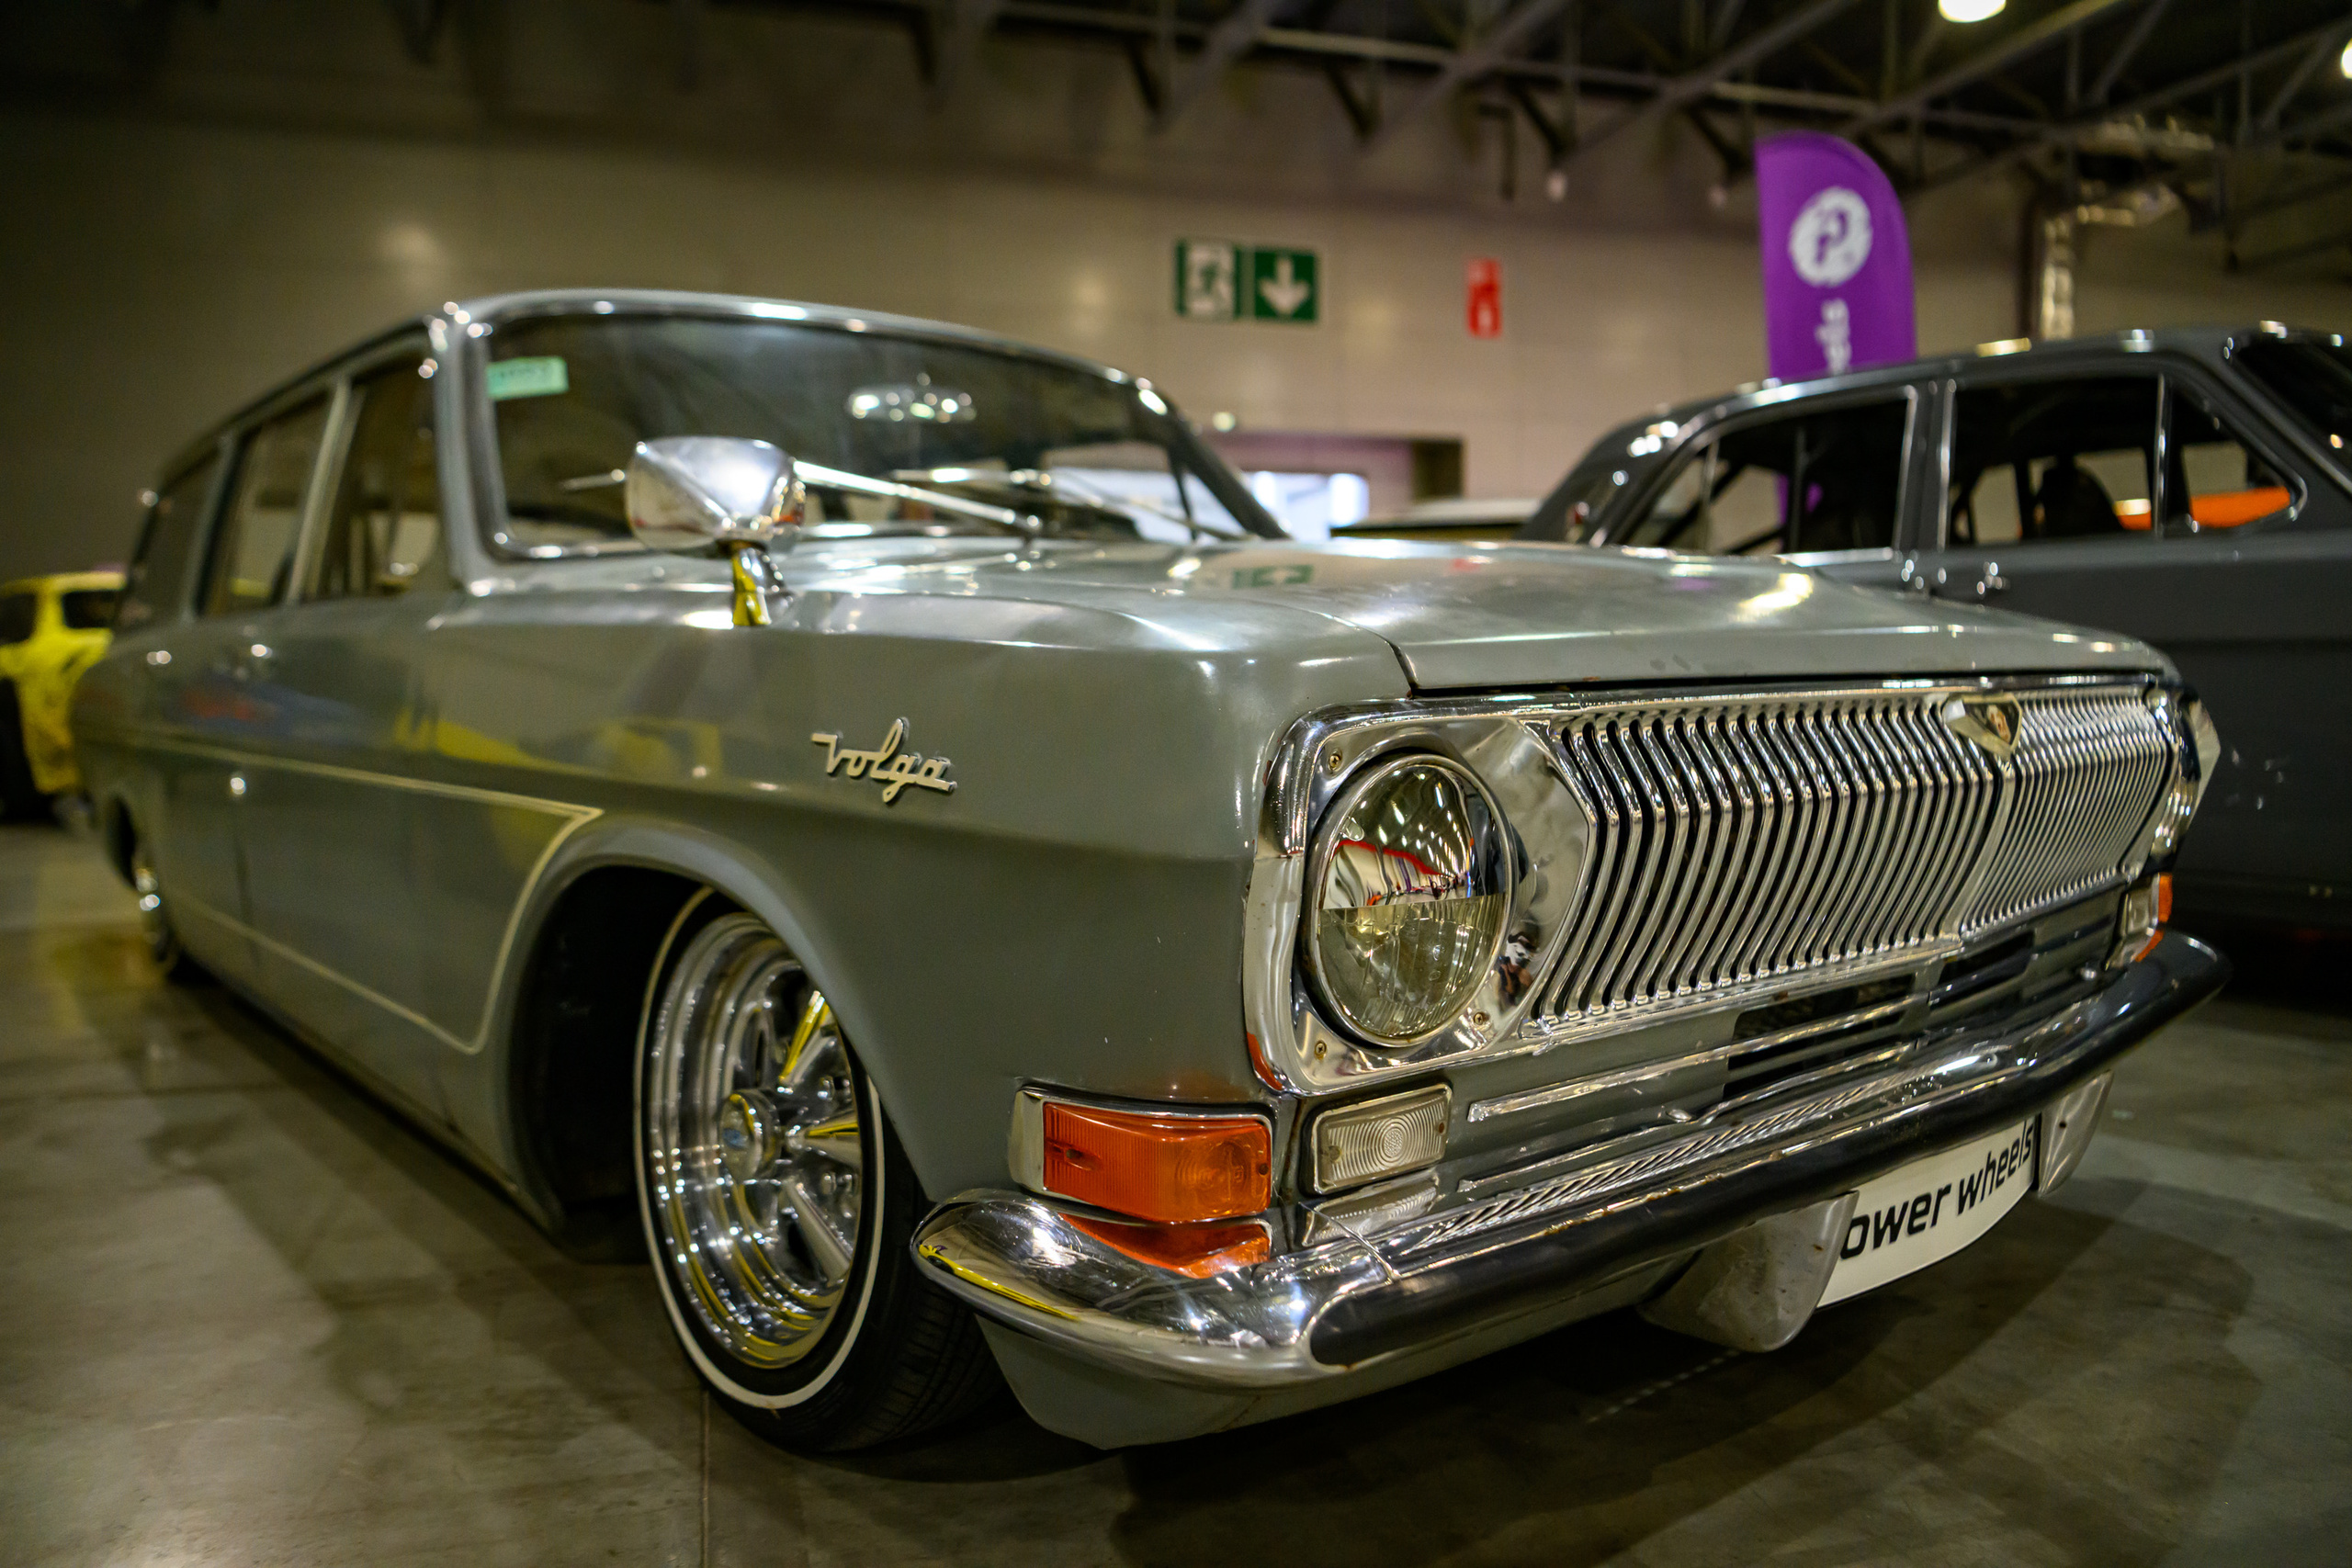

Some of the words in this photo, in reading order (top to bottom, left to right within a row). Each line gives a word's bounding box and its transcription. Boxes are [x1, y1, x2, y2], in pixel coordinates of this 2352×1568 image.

[811, 716, 956, 803] Volga
[1840, 1183, 1951, 1259] ower
[1957, 1121, 2033, 1215] wheels
